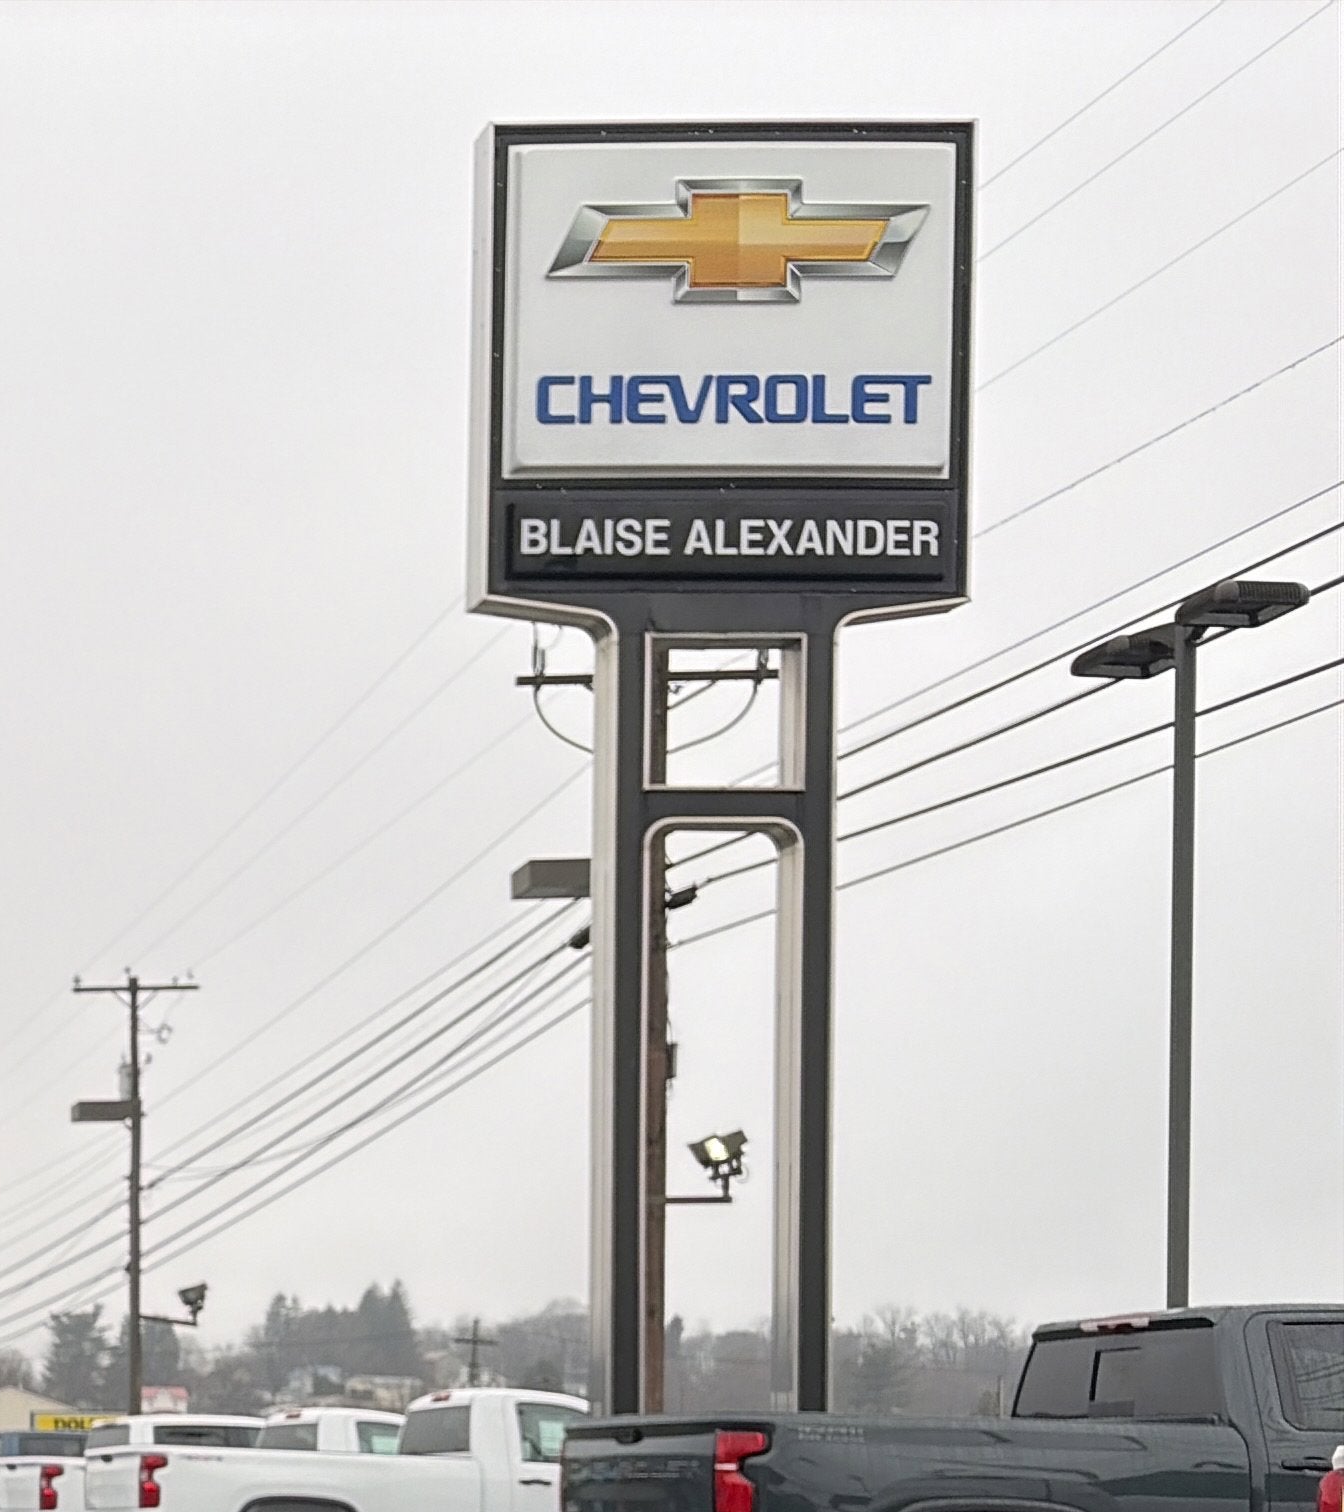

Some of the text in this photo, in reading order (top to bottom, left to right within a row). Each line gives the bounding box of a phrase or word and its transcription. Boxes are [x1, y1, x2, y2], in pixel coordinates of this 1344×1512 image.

[536, 374, 932, 425] CHEVROLET
[519, 518, 940, 556] BLAISE ALEXANDER
[53, 1416, 94, 1431] DOL
